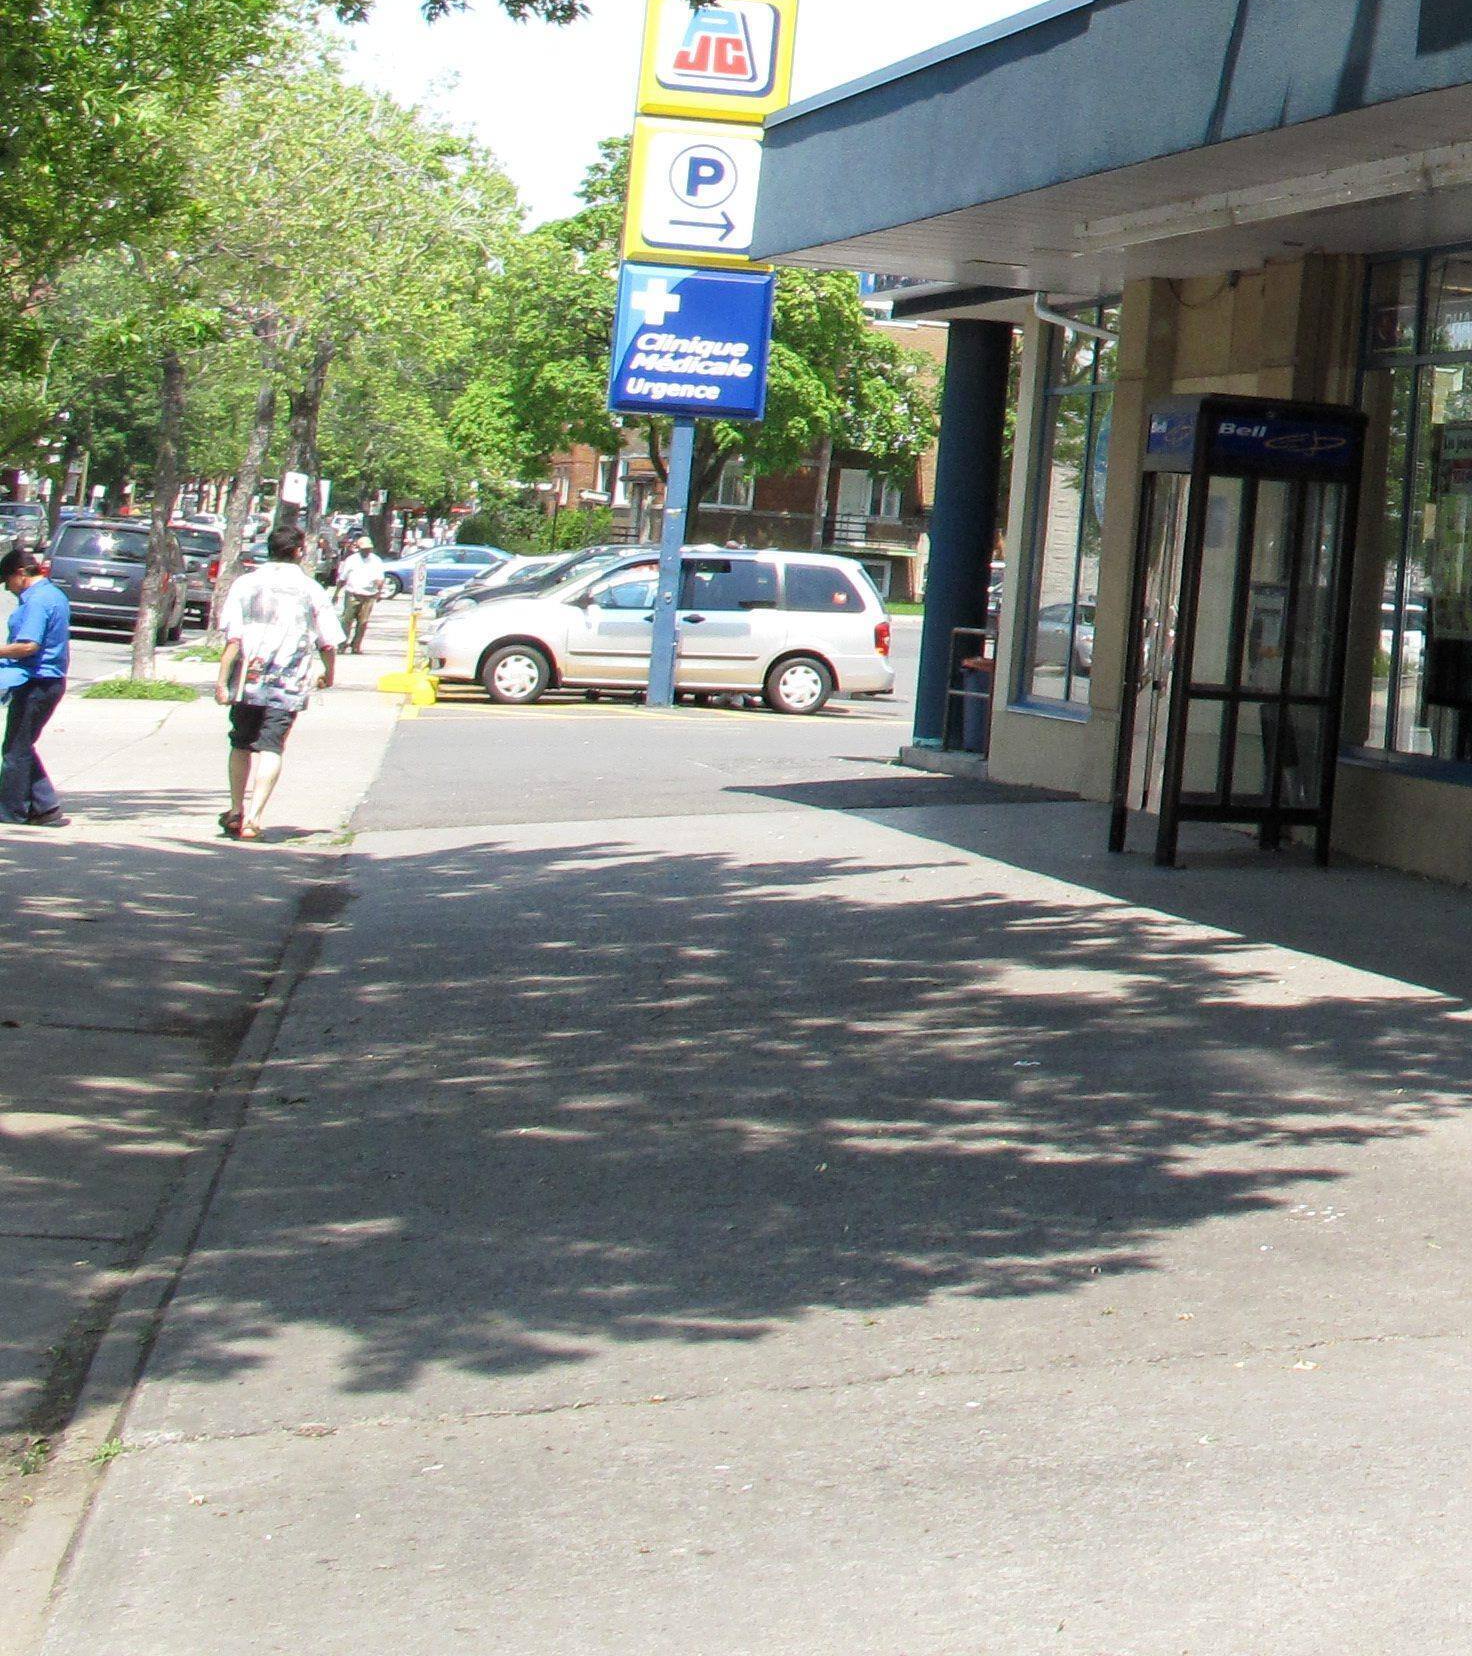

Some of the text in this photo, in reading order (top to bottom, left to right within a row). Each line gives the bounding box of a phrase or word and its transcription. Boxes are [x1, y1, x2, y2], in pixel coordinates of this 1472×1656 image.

[685, 156, 725, 197] P
[637, 332, 749, 358] Clinique
[629, 352, 753, 378] Médicale
[626, 377, 721, 400] Urgence
[1218, 422, 1267, 438] Bell
